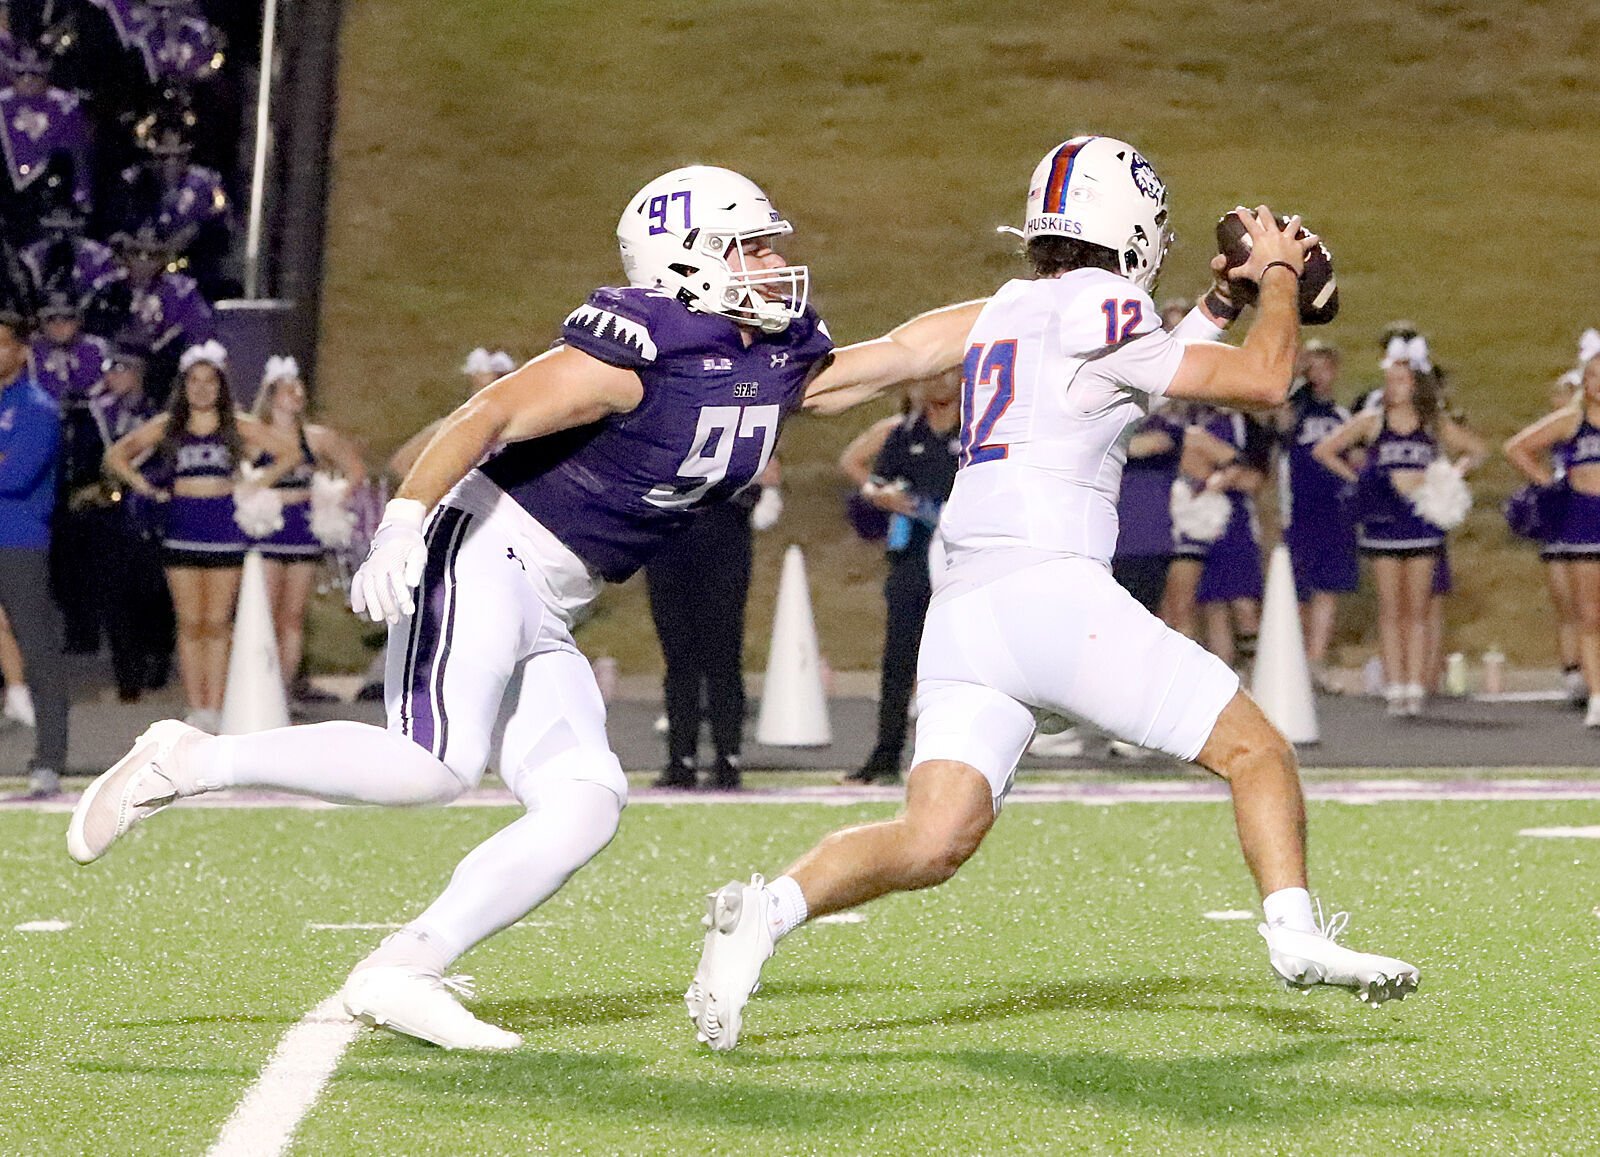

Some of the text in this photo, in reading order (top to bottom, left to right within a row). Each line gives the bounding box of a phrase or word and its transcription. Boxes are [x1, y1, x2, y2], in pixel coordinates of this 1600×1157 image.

[648, 191, 692, 236] 97
[1027, 217, 1082, 235] HUSKIES
[1101, 298, 1143, 344] 12
[958, 339, 1018, 470] 12
[641, 404, 780, 512] 97
